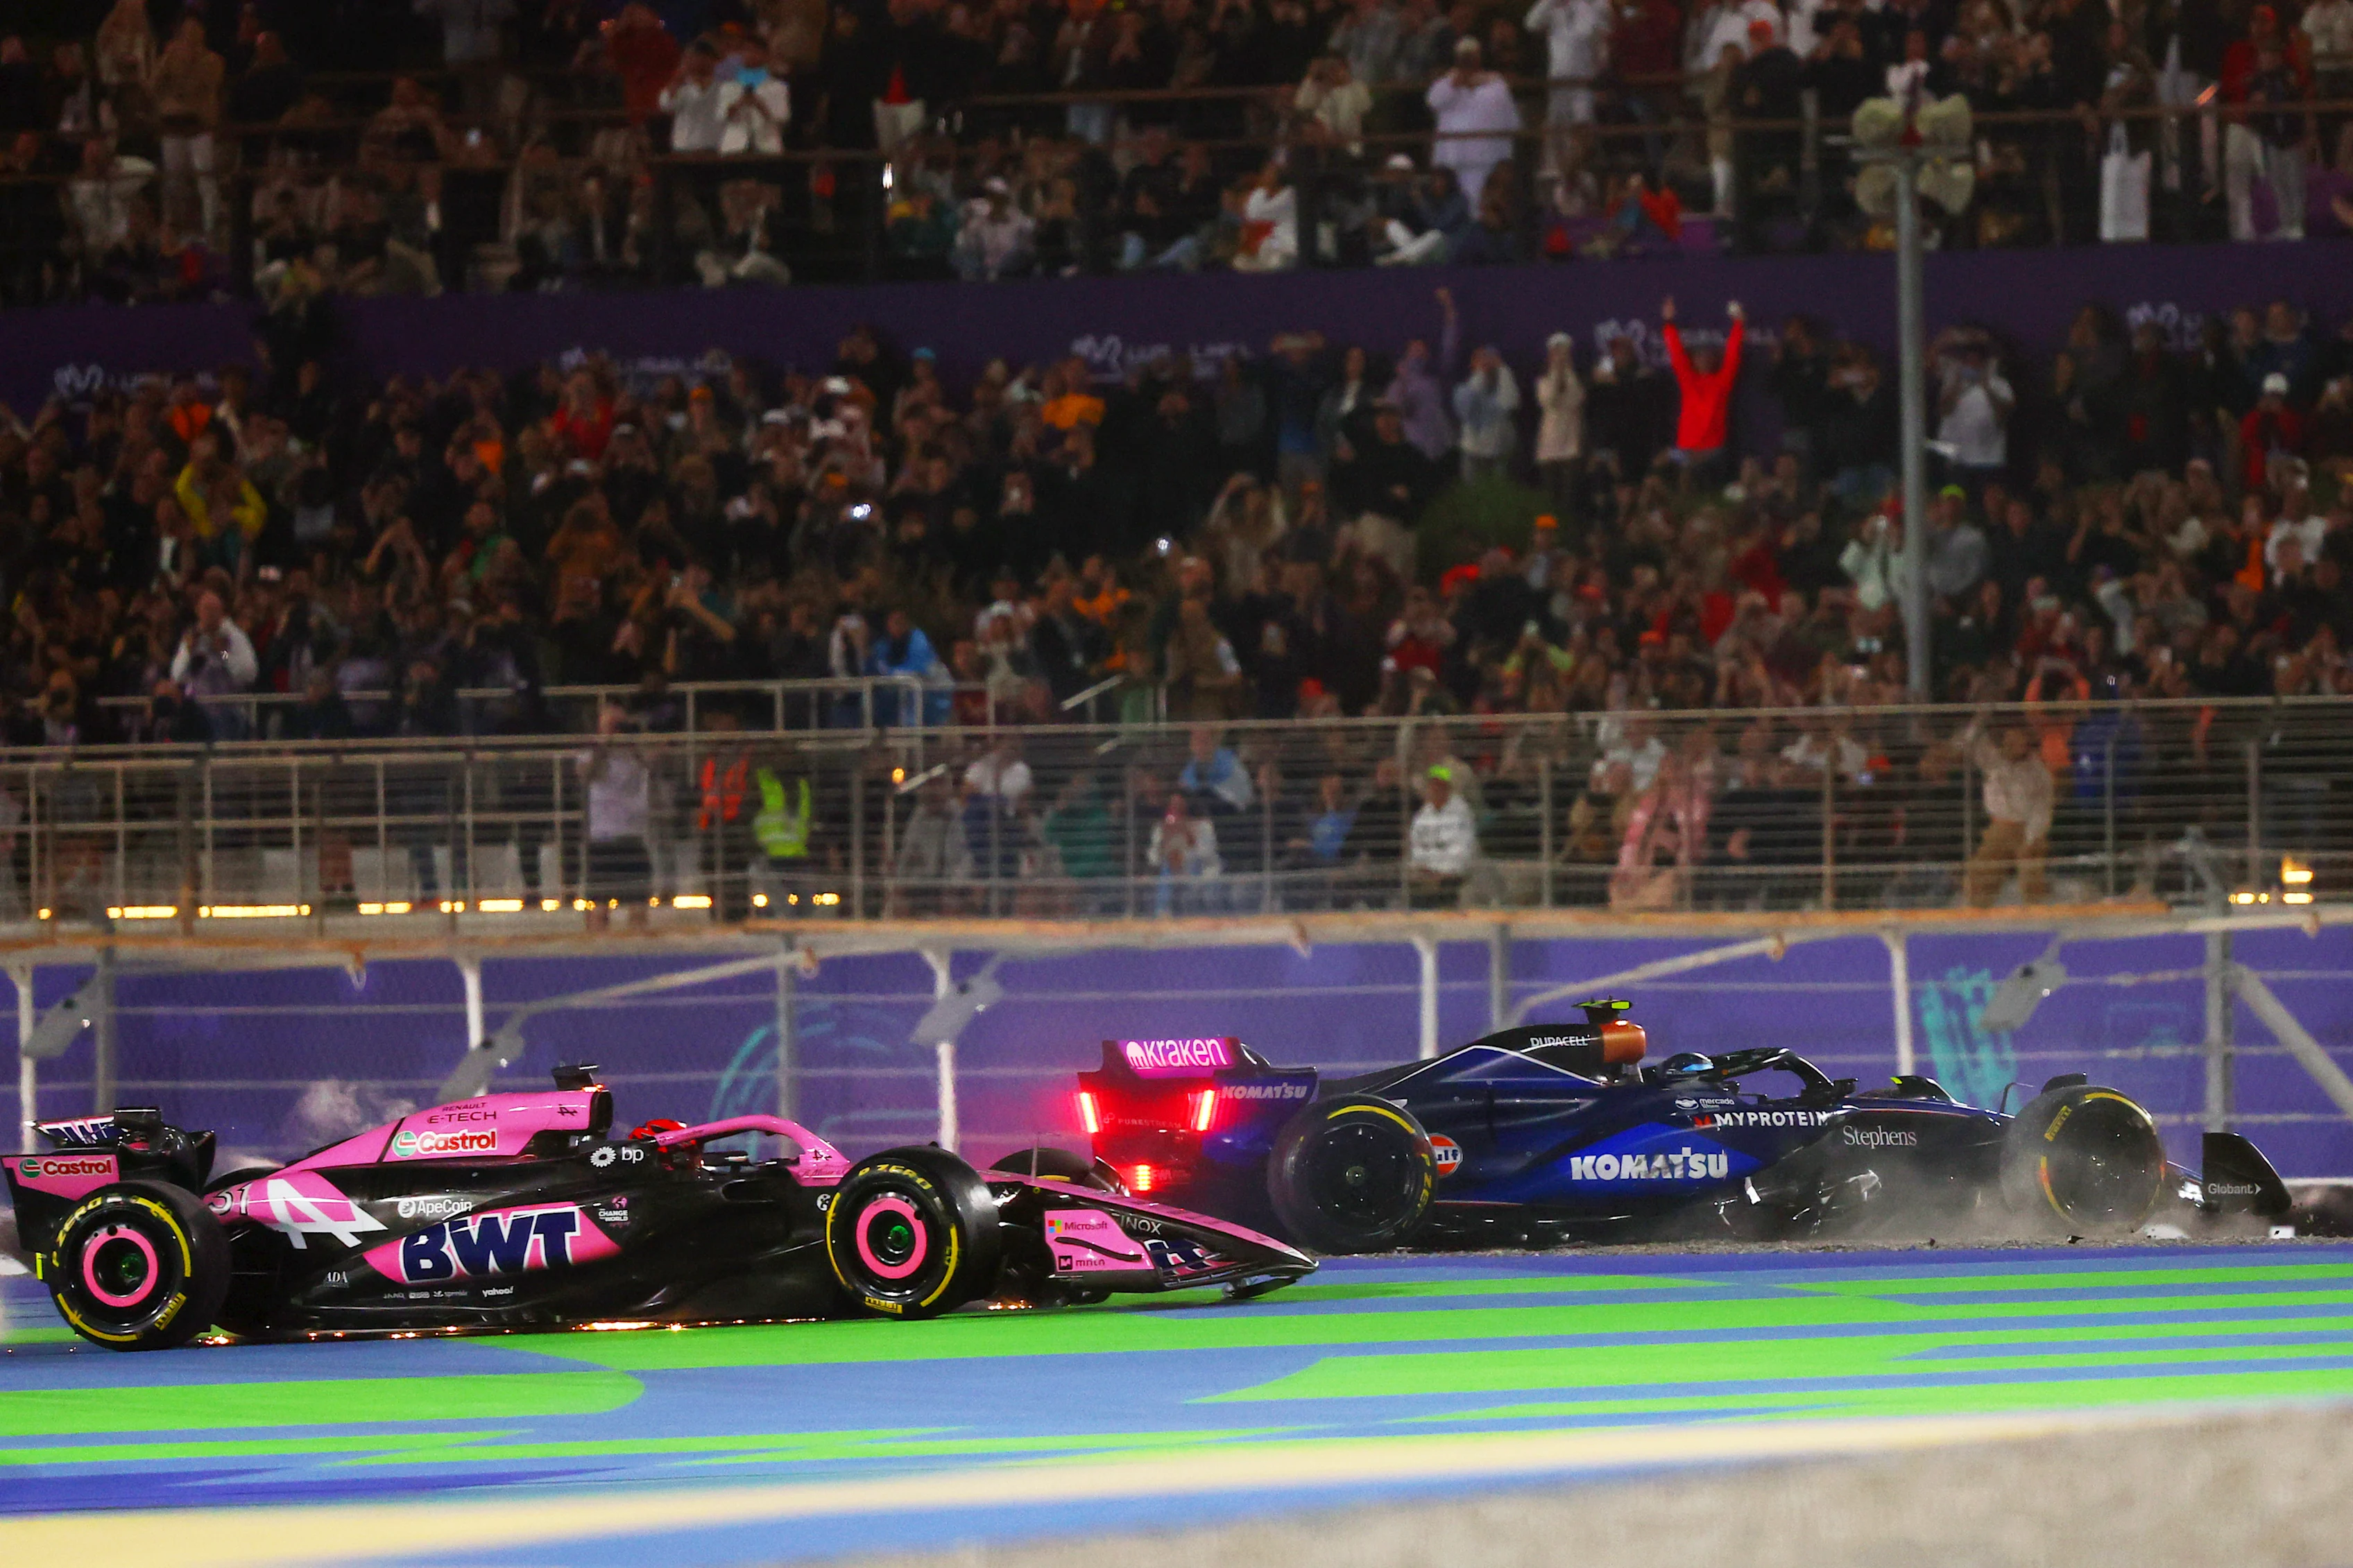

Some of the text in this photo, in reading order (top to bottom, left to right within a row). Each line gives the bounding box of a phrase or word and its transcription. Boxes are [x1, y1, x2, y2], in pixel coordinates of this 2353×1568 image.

[1530, 1035, 1589, 1047] DURACELL
[1143, 1039, 1227, 1067] kraken
[1221, 1083, 1308, 1099] KOMATSU
[442, 1101, 488, 1112] RENAULT
[1699, 1097, 1735, 1105] mercado
[428, 1110, 497, 1124] E-TECH
[1714, 1111, 1828, 1128] MYPROTEIN
[416, 1129, 498, 1154] Castrol
[1842, 1124, 1917, 1149] Stephens
[621, 1146, 644, 1164] bp
[1437, 1149, 1460, 1161] ulf
[1570, 1146, 1729, 1180] KOMATSU
[43, 1158, 112, 1176] Castrol
[877, 1164, 933, 1190] ZERO
[2208, 1182, 2253, 1195] Globant
[417, 1199, 472, 1215] ApeCoin
[1065, 1221, 1108, 1233] Microsoft
[399, 1208, 581, 1283] BWT
[325, 1270, 348, 1283] ADA
[482, 1285, 514, 1298] yahoo!
